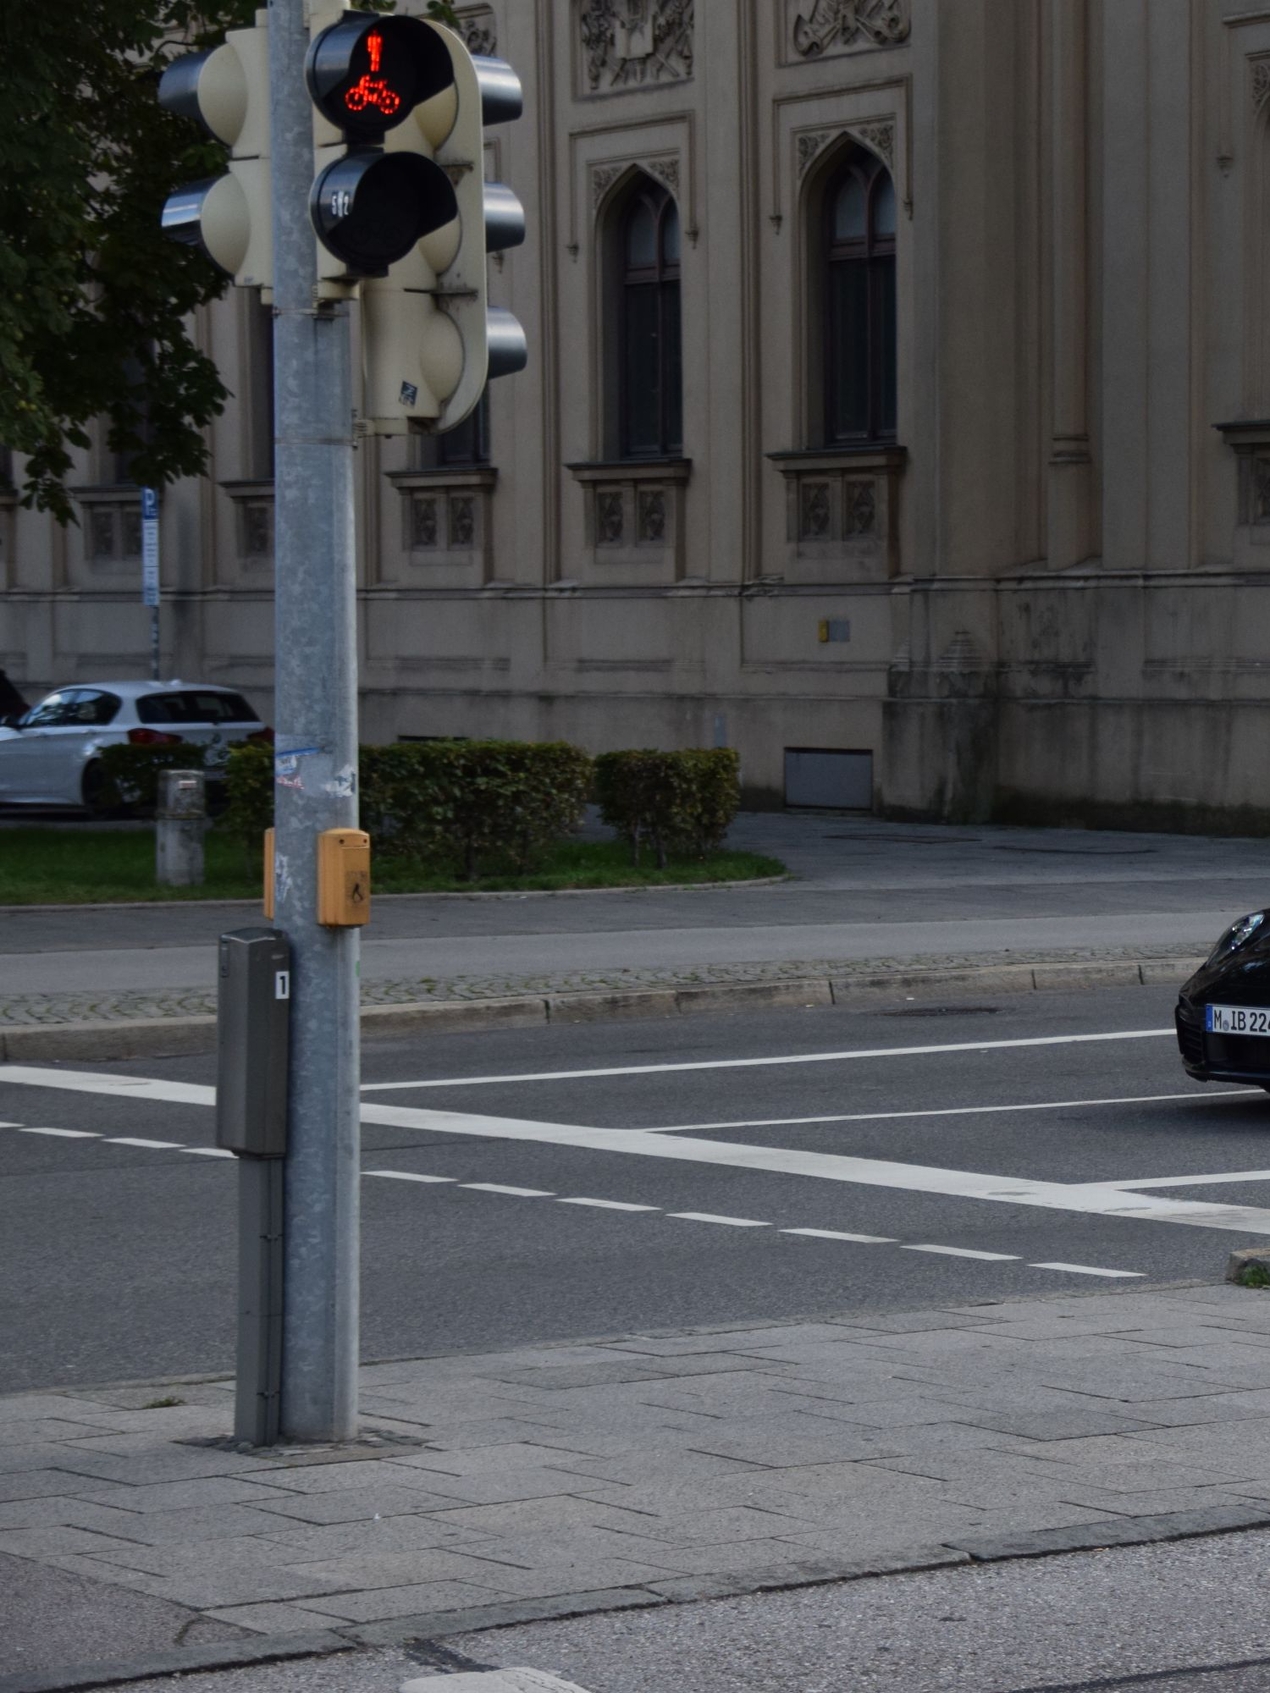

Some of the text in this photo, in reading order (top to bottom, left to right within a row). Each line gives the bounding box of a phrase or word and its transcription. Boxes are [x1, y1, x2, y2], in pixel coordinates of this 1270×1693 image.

[279, 975, 286, 995] 1
[1214, 1010, 1222, 1029] M
[1231, 1010, 1246, 1031] IB
